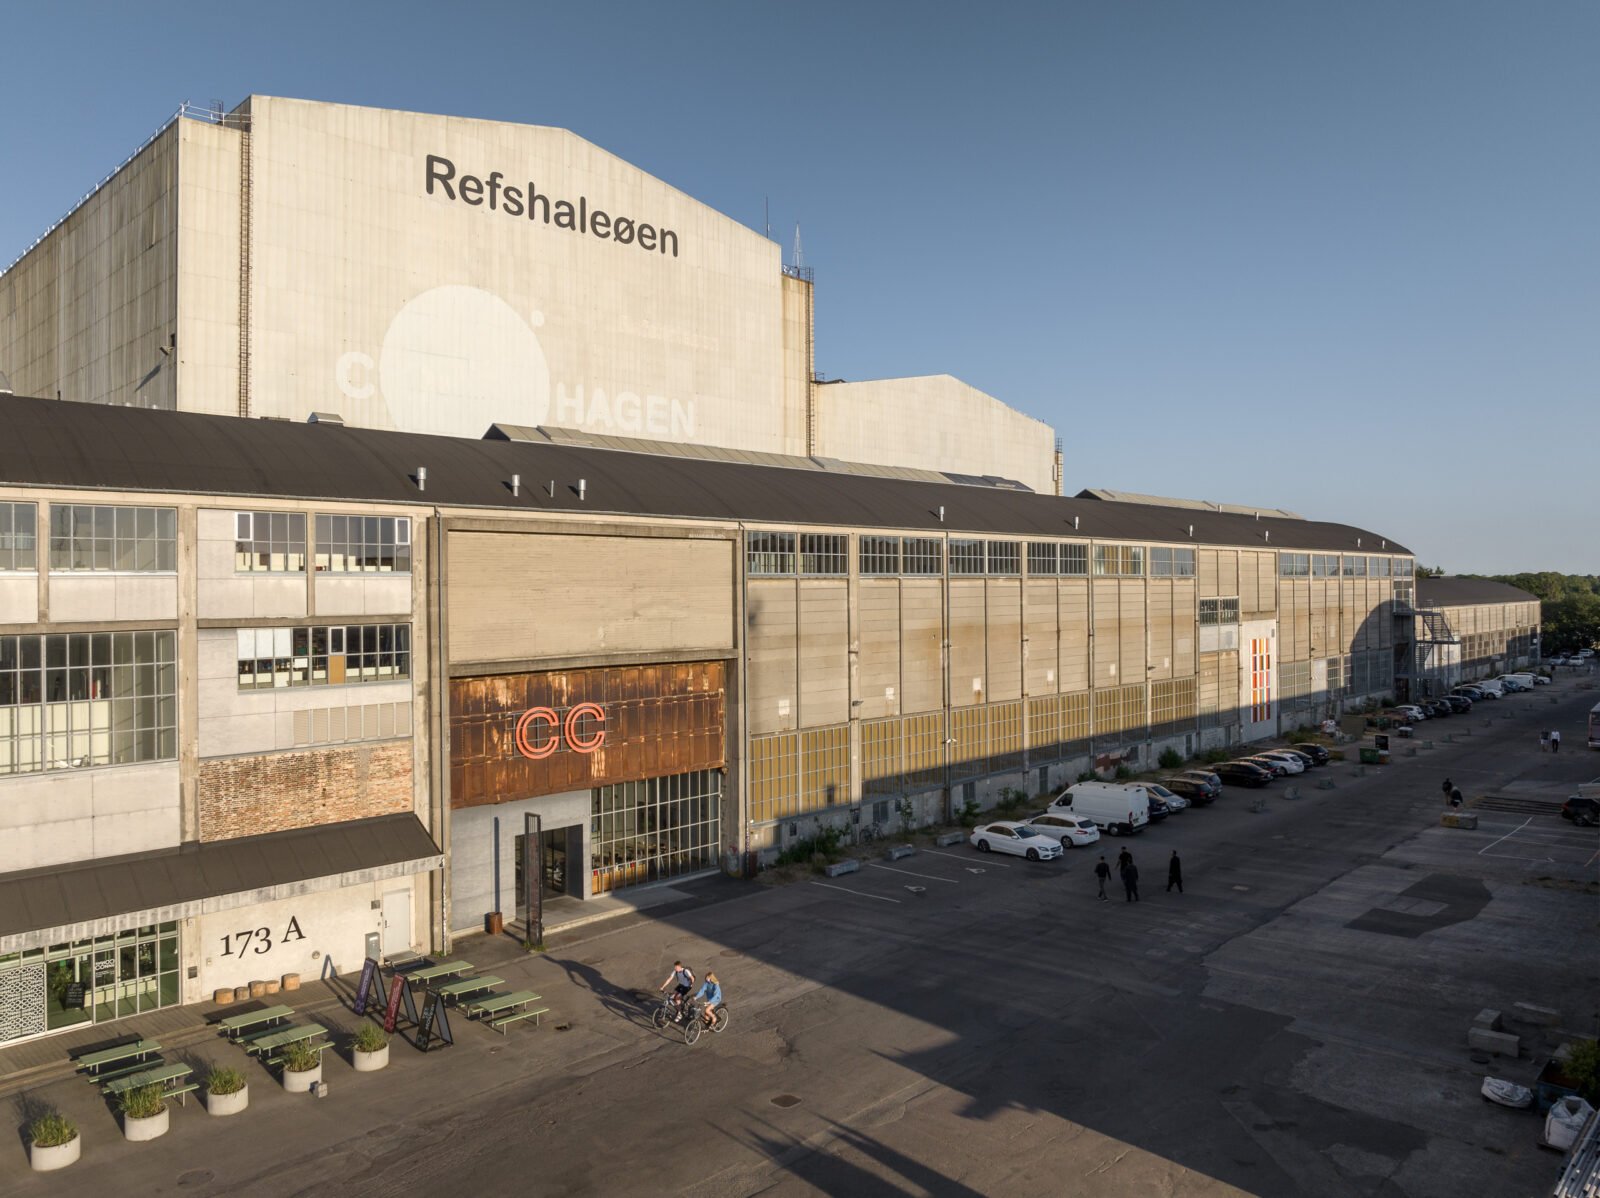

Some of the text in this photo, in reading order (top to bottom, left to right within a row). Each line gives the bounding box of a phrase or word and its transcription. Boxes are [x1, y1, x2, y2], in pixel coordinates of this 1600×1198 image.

[425, 154, 679, 258] Refshaleøen
[556, 382, 695, 438] HAGEN
[516, 702, 605, 760] CC
[220, 915, 307, 959] 173 A
